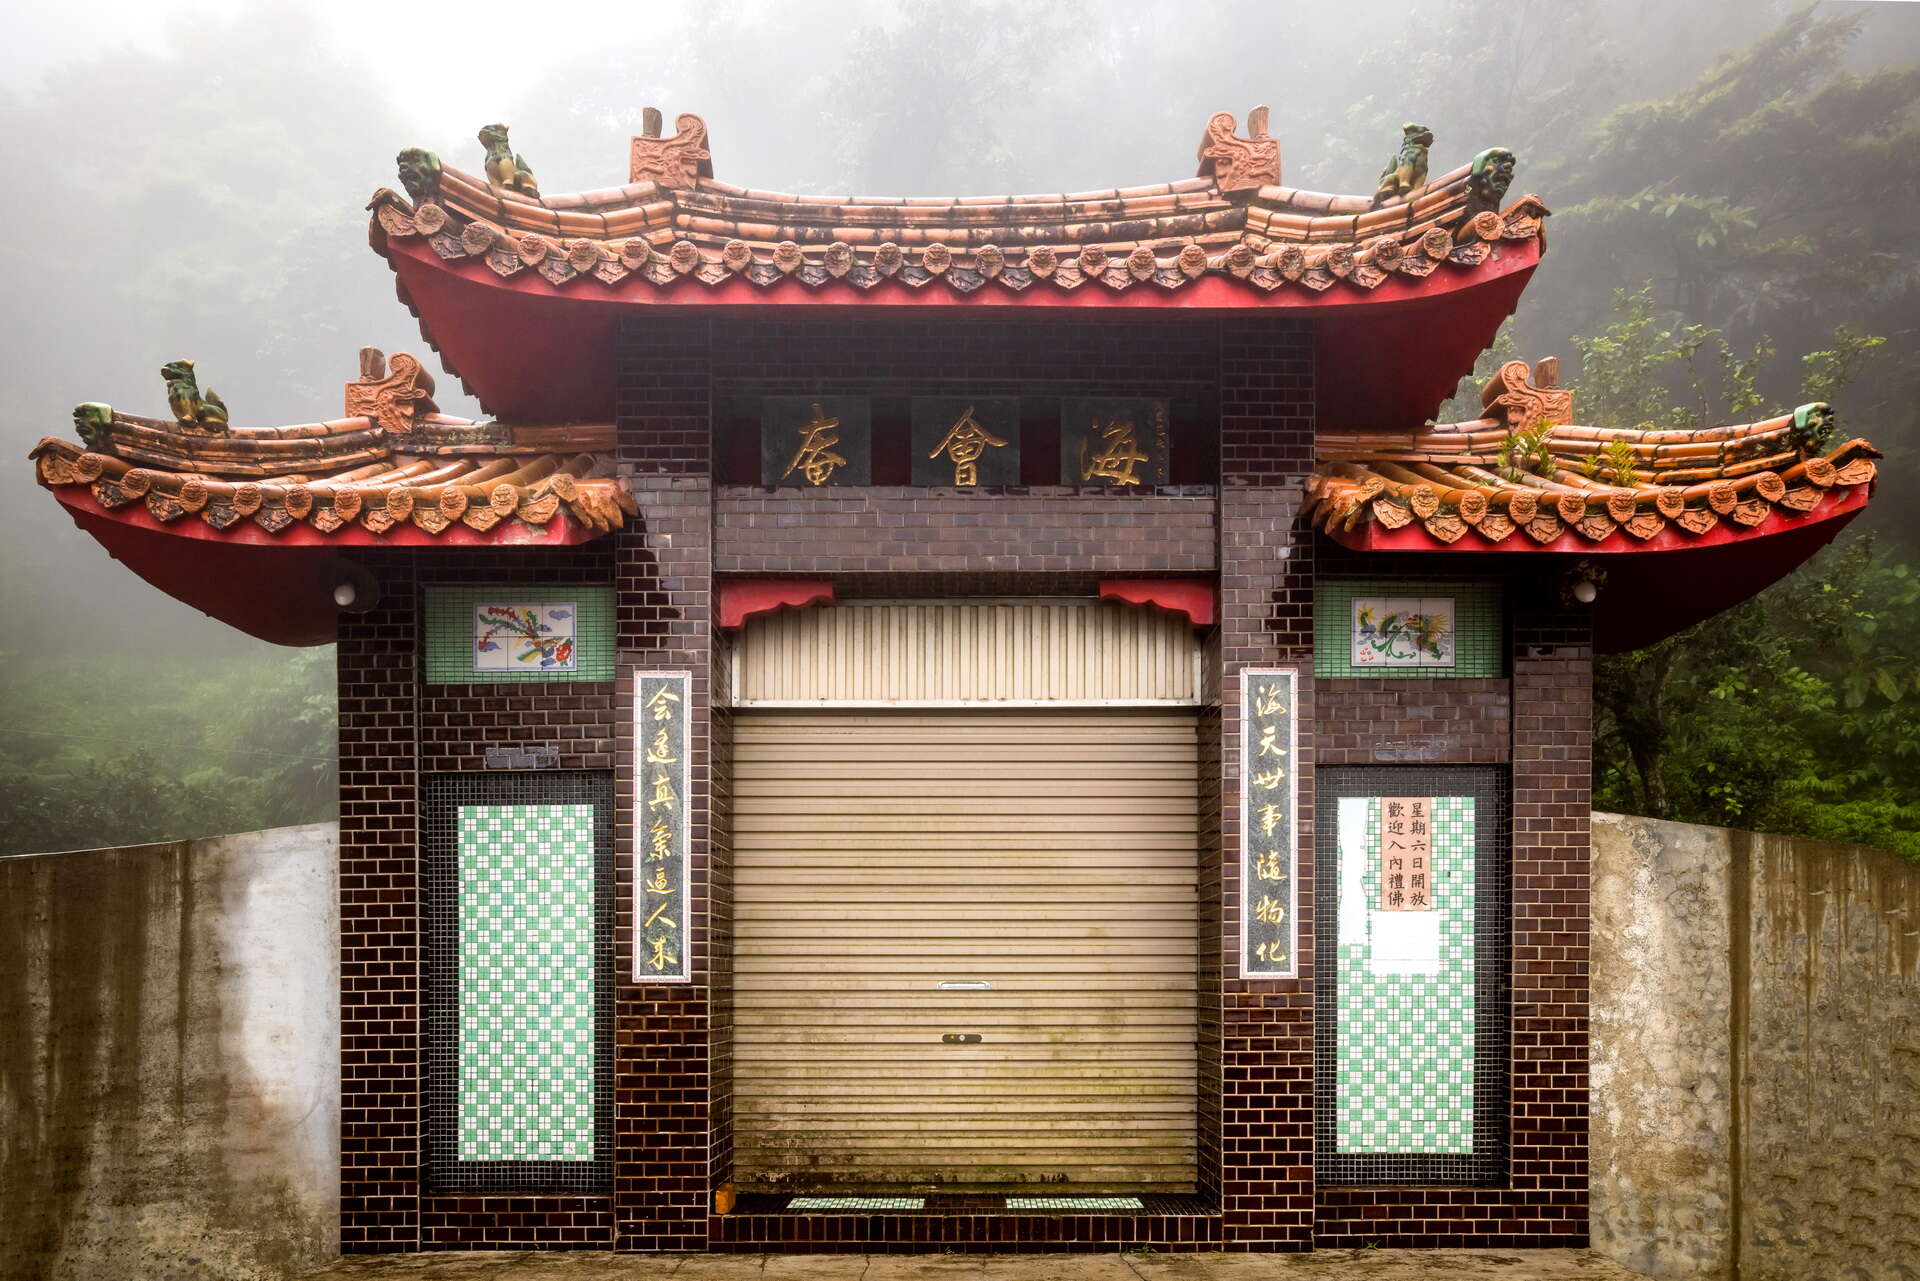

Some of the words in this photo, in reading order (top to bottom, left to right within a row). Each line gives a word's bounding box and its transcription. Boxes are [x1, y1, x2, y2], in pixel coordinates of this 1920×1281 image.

[1387, 801, 1406, 908] 歡迎入內禮佛
[1409, 802, 1428, 906] 星期六日開放
